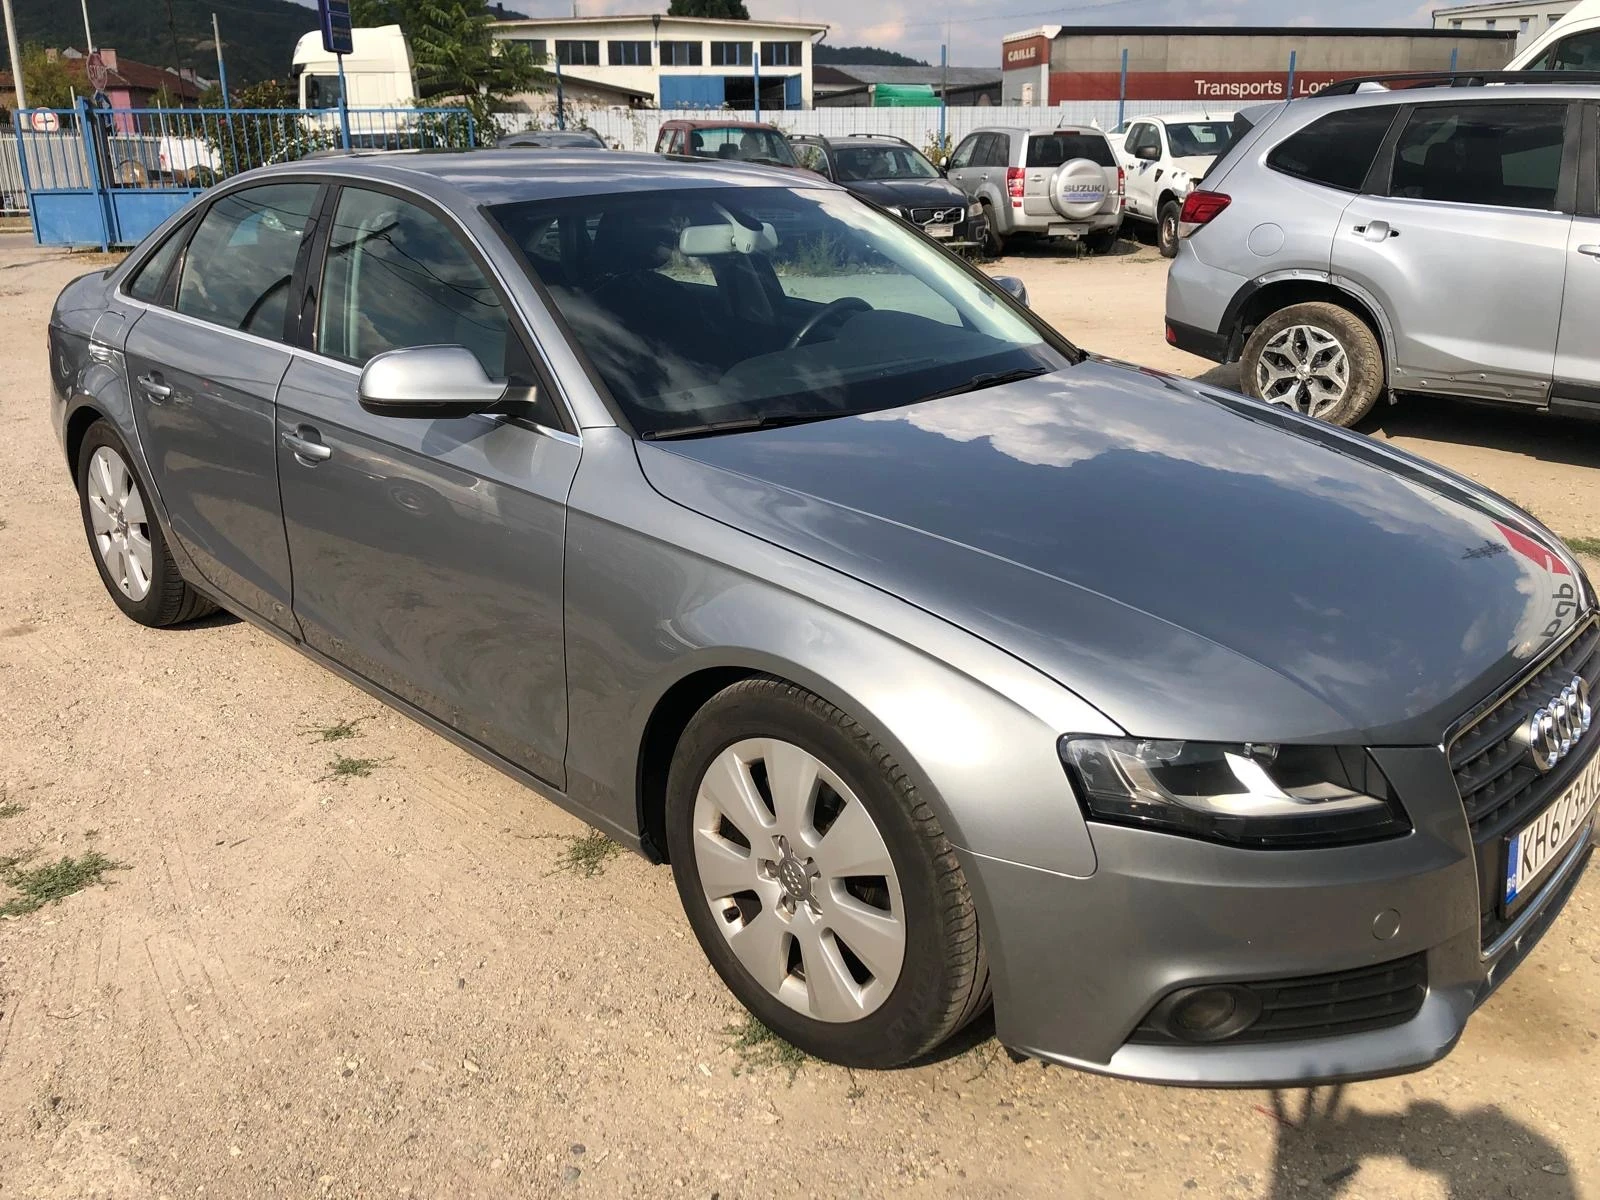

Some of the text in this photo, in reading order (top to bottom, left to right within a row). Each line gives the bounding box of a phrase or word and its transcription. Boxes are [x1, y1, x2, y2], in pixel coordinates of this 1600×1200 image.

[1007, 47, 1036, 62] CAILLE
[1194, 79, 1283, 98] Transports
[1063, 184, 1105, 192] SUZUKI
